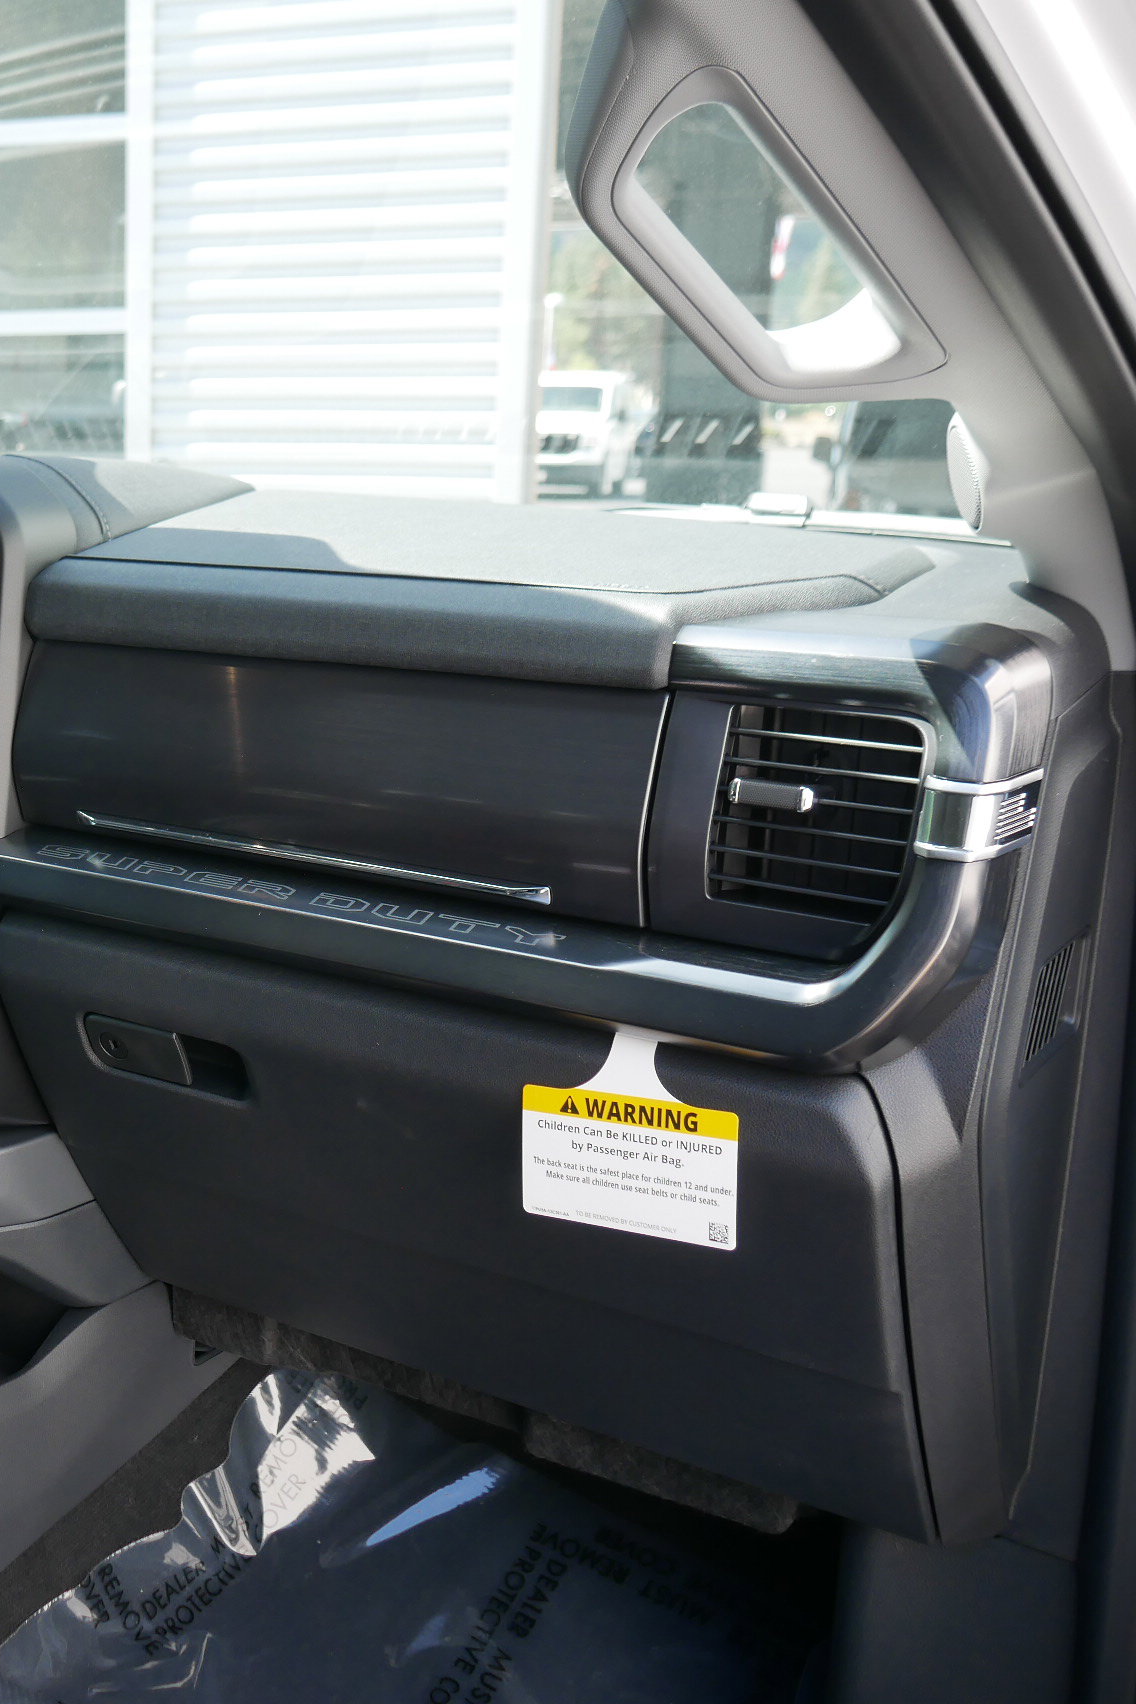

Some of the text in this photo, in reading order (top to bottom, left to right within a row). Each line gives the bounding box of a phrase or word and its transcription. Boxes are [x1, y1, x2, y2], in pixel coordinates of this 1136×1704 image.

[36, 844, 566, 948] SUPER DUTY
[585, 1097, 699, 1132] WARNING
[537, 1119, 723, 1155] Children Can Be KILLED or INJURED
[571, 1140, 684, 1168] by Passenger Air Bag.
[533, 1156, 735, 1197] The back seat is the safest place for children 12 and under.
[545, 1170, 720, 1207] Make sure all children use seat belts or child seats.
[584, 1211, 592, 1219] BE
[593, 1213, 620, 1223] REMOVED
[621, 1217, 629, 1225] BY
[629, 1219, 660, 1230] CUSTOMER
[660, 1225, 677, 1233] ONLY
[454, 1546, 542, 1676] PROTECTIVE
[464, 1557, 568, 1704] DEALER MUS
